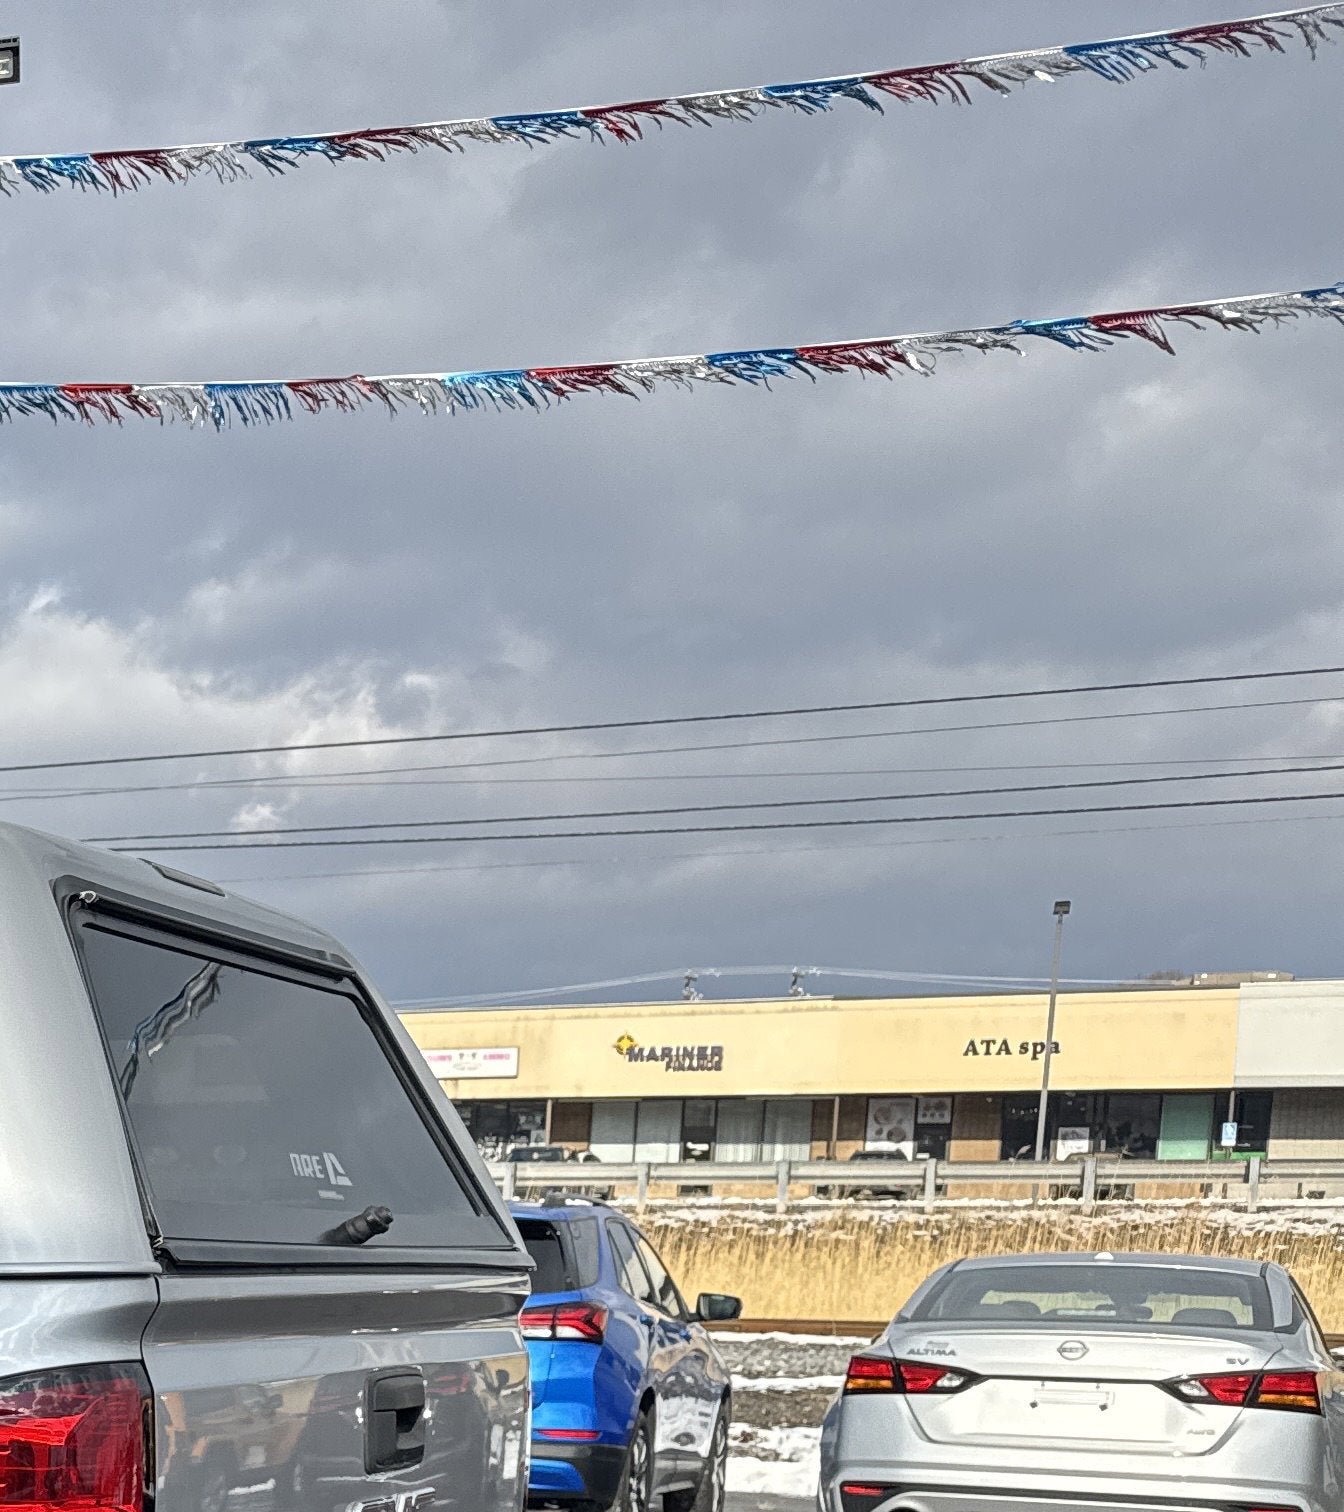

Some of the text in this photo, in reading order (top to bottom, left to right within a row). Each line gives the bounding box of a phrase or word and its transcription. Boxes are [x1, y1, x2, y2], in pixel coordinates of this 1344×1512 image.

[626, 1045, 723, 1063] MARINER
[962, 1038, 1061, 1062] ATA spa
[906, 1348, 957, 1357] ALTIMA
[1226, 1358, 1250, 1366] SV
